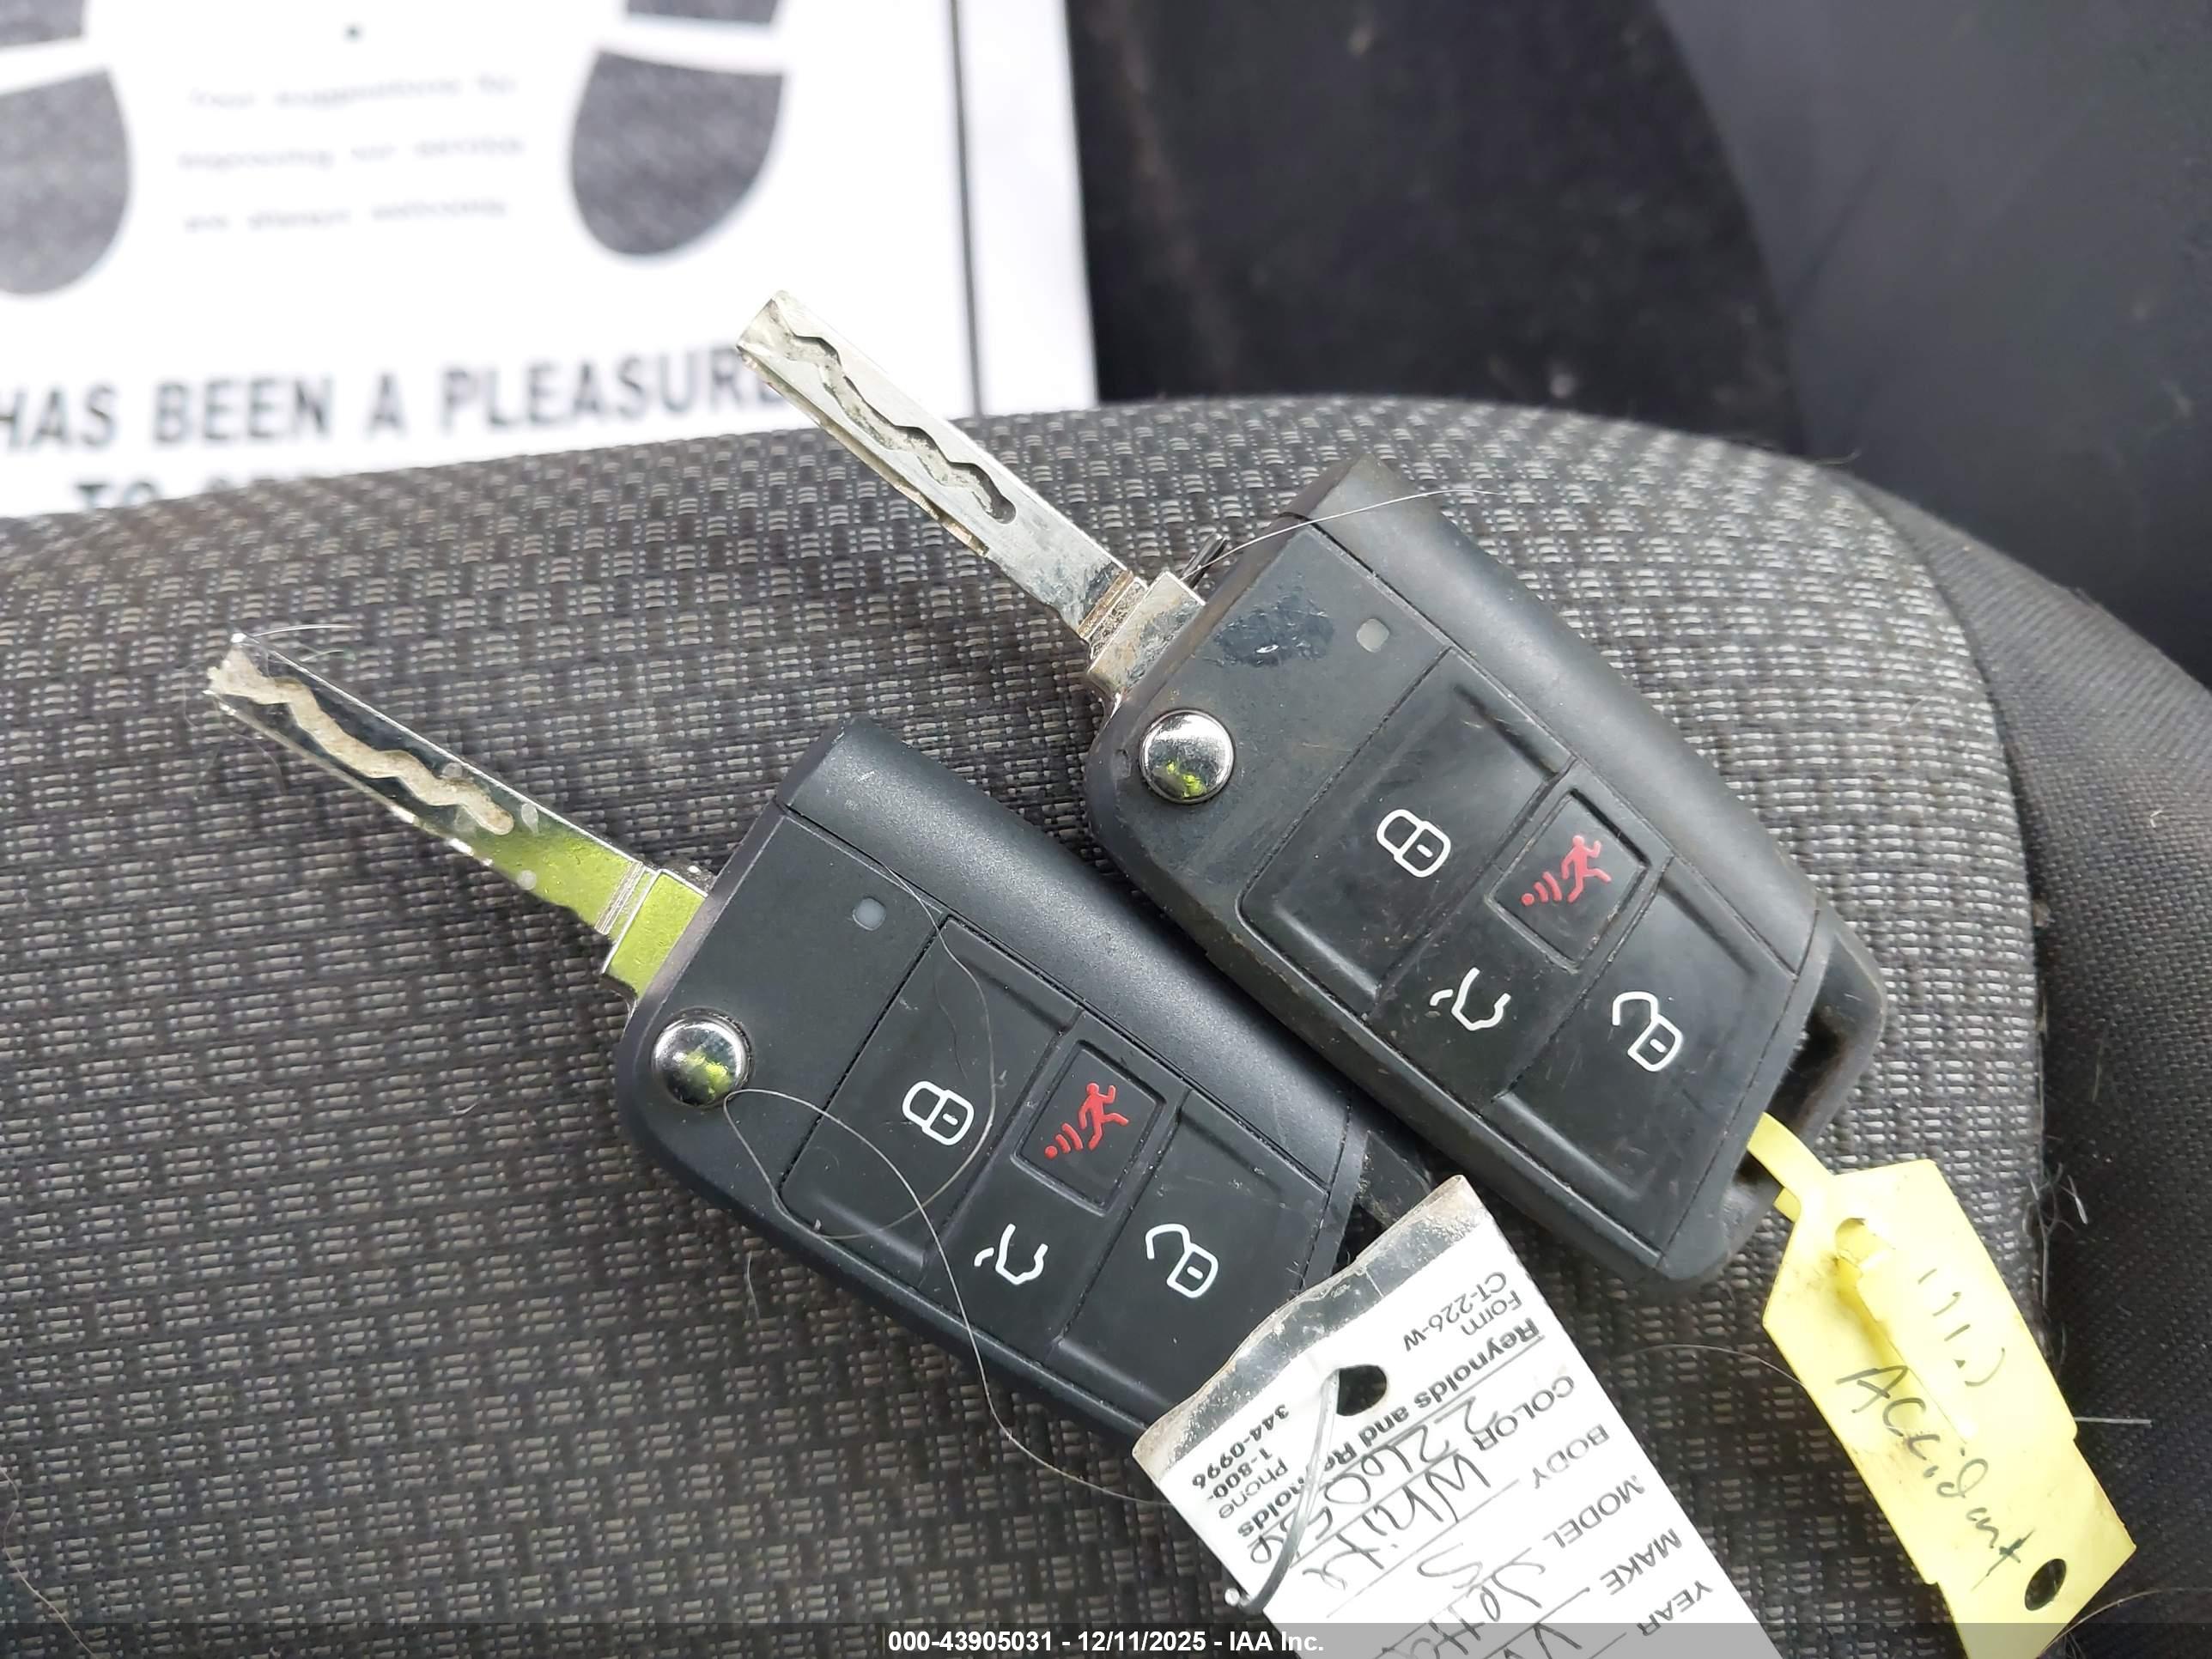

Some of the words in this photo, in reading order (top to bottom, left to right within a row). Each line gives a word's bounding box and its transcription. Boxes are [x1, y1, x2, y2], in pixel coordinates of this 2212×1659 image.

[153, 374, 334, 448] BEEN
[364, 369, 407, 434] A
[1403, 1271, 1507, 1352] CT-226-W
[1461, 1290, 1522, 1336] Form
[1413, 1317, 1540, 1410] Reynolds
[1192, 1404, 1289, 1490] 344-0996
[1358, 1405, 1410, 1449] and
[1472, 1376, 1575, 1451] COLOR
[1206, 1447, 1273, 1500] 1-800-
[1218, 1457, 1289, 1519] Phone
[1237, 1442, 1358, 1537] Renolds
[1533, 1424, 1610, 1489] BODY
[1303, 1453, 1492, 1590] White
[1542, 1475, 1645, 1548] MODEL
[1600, 1528, 1682, 1595] MAKE
[1636, 1580, 1714, 1637] YEAR
